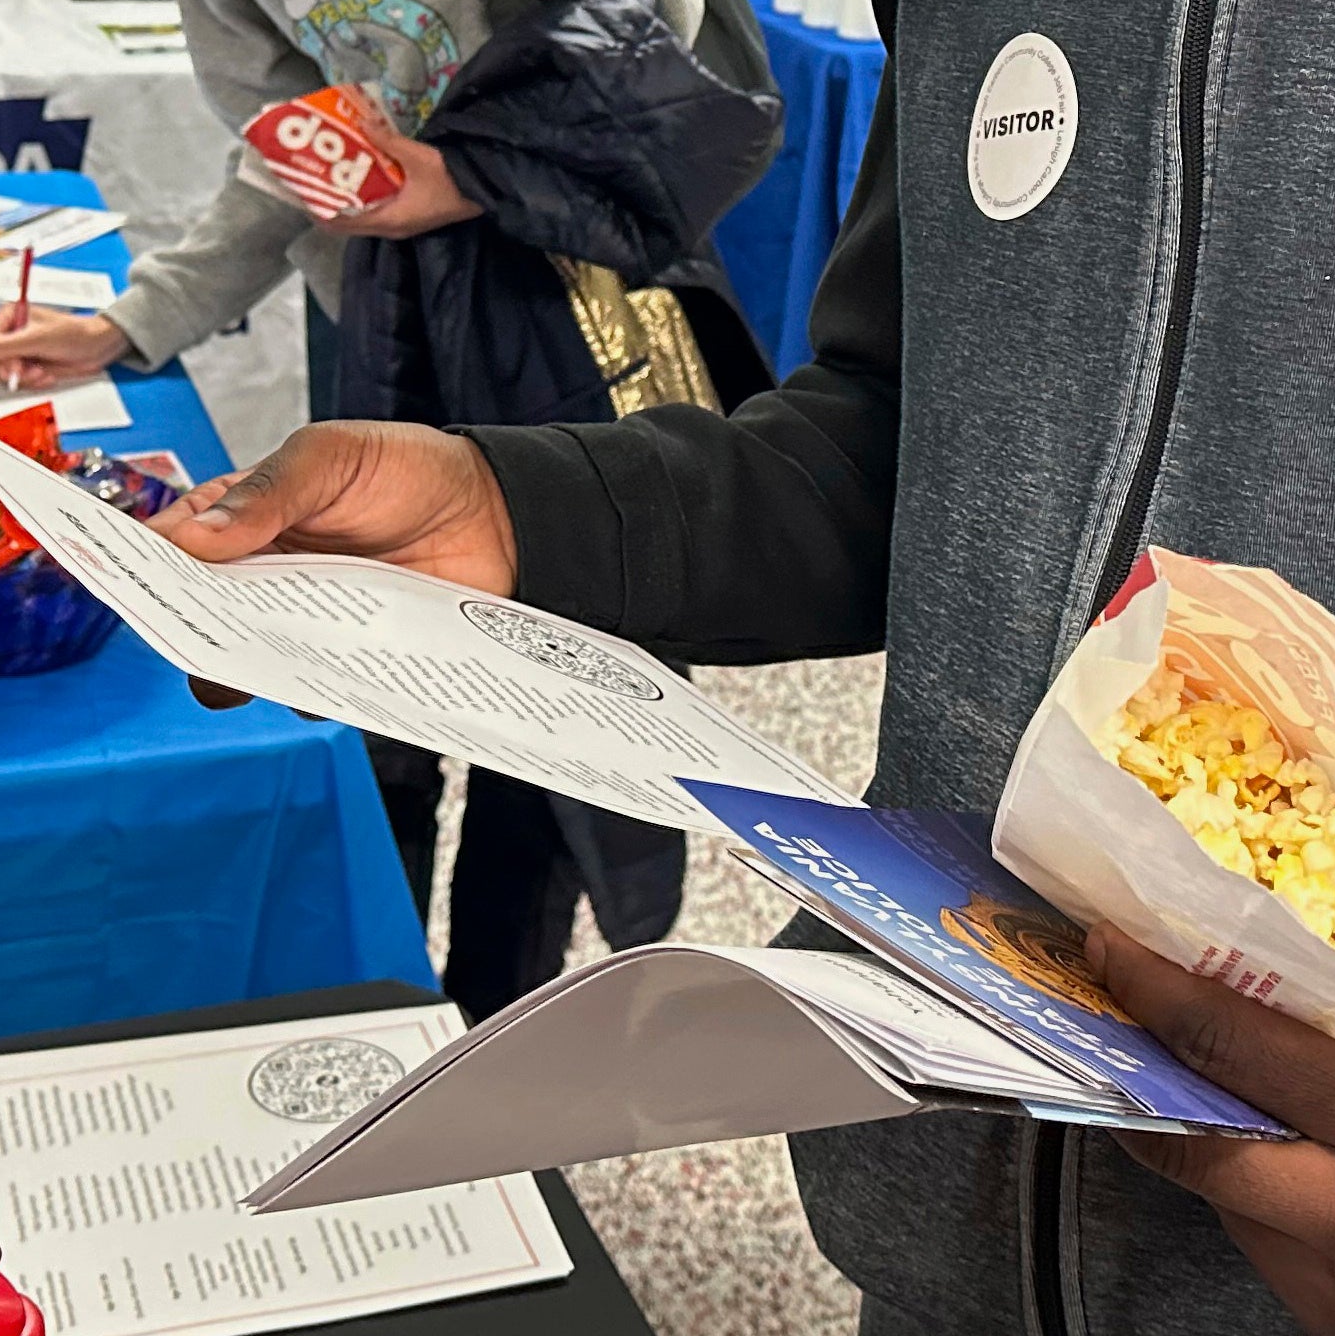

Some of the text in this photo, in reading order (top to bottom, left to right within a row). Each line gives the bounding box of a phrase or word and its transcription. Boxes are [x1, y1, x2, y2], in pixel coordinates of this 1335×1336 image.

[275, 114, 375, 194] POP
[983, 109, 1054, 139] VISITOR
[752, 821, 1140, 1074] PENNSYLVANIA
[791, 836, 968, 957] POLICE
[976, 963, 1146, 1069] STATE
